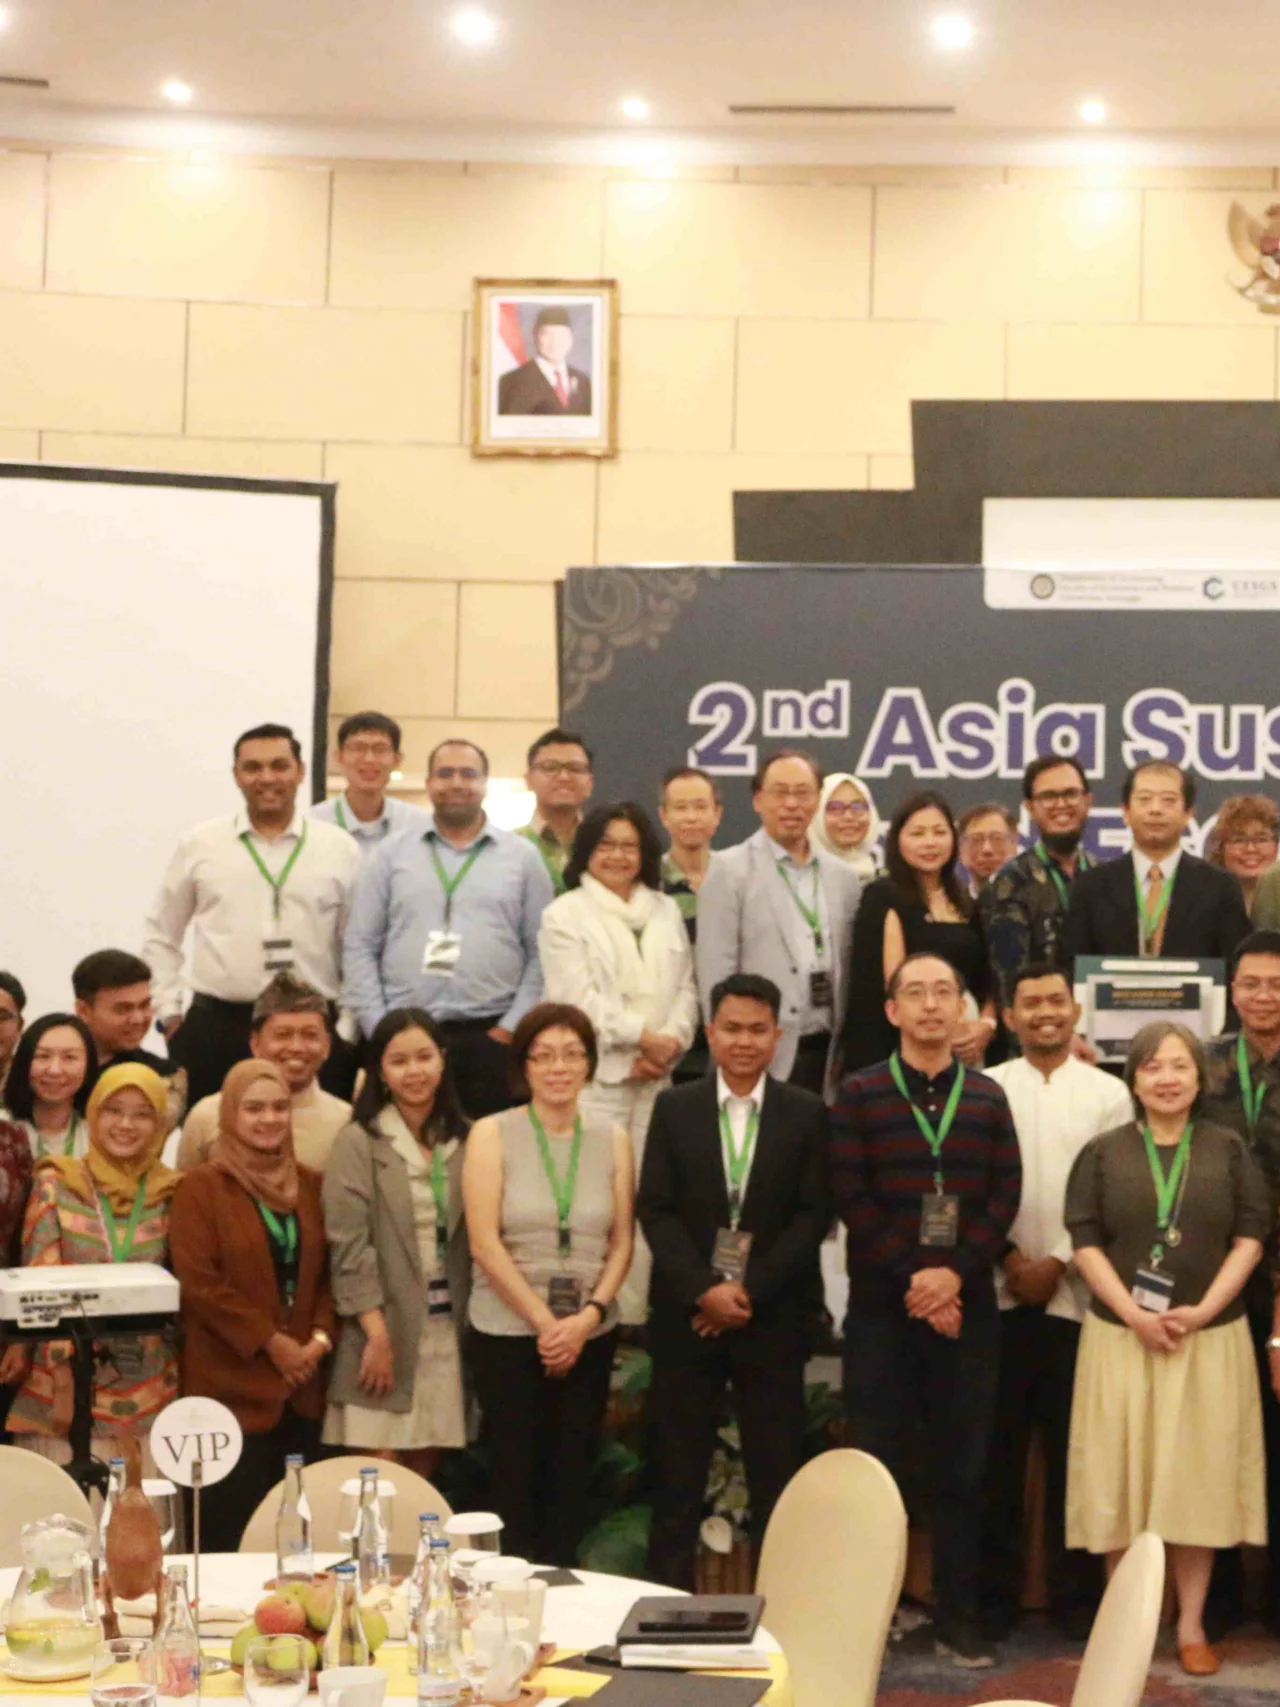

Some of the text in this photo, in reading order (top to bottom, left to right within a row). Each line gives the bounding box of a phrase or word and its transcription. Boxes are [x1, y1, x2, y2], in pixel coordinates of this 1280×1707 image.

[688, 680, 850, 776] 2nd
[857, 678, 1106, 779] Asia
[161, 1431, 231, 1464] VIP
